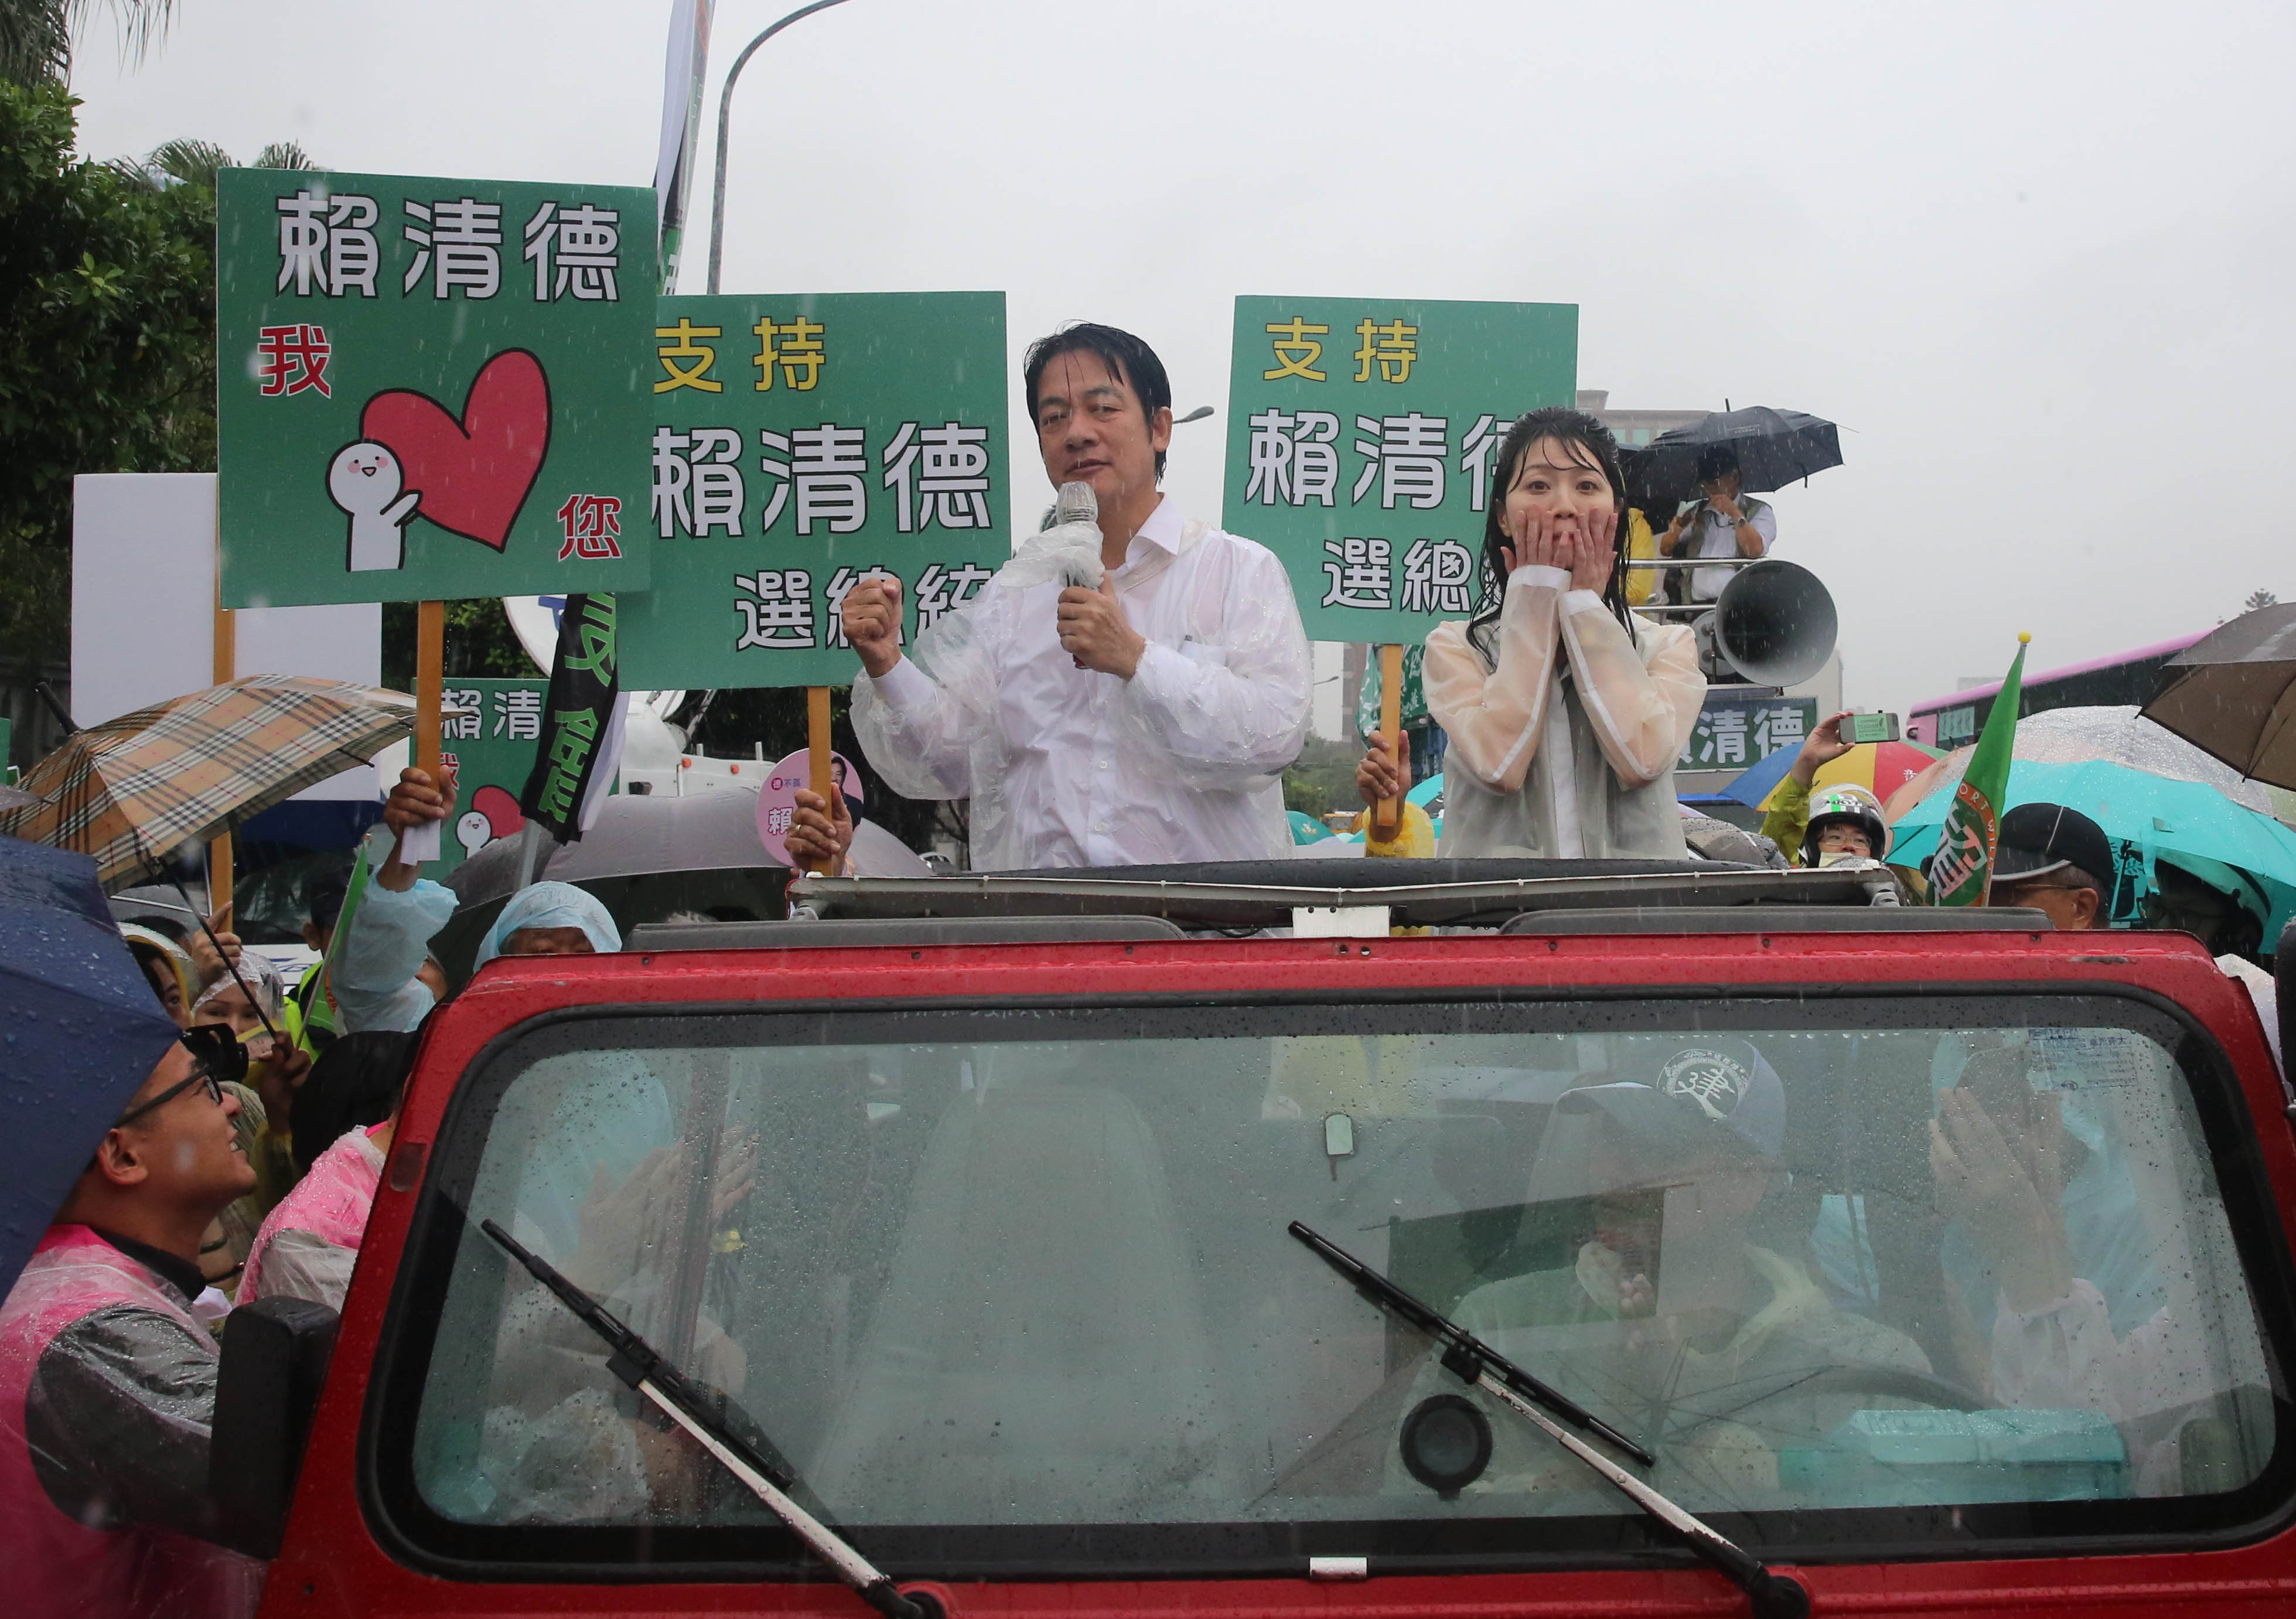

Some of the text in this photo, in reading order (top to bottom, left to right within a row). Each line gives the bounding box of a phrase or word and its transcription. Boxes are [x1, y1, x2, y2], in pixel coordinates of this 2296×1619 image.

[276, 190, 620, 302] 賴清德
[257, 323, 331, 399] 我
[654, 316, 824, 394] 支持
[1263, 316, 1418, 384] 支持
[651, 421, 992, 539] 賴清德
[557, 494, 622, 561] 您
[1321, 537, 1500, 615] 選總
[1680, 706, 1806, 764] 清德
